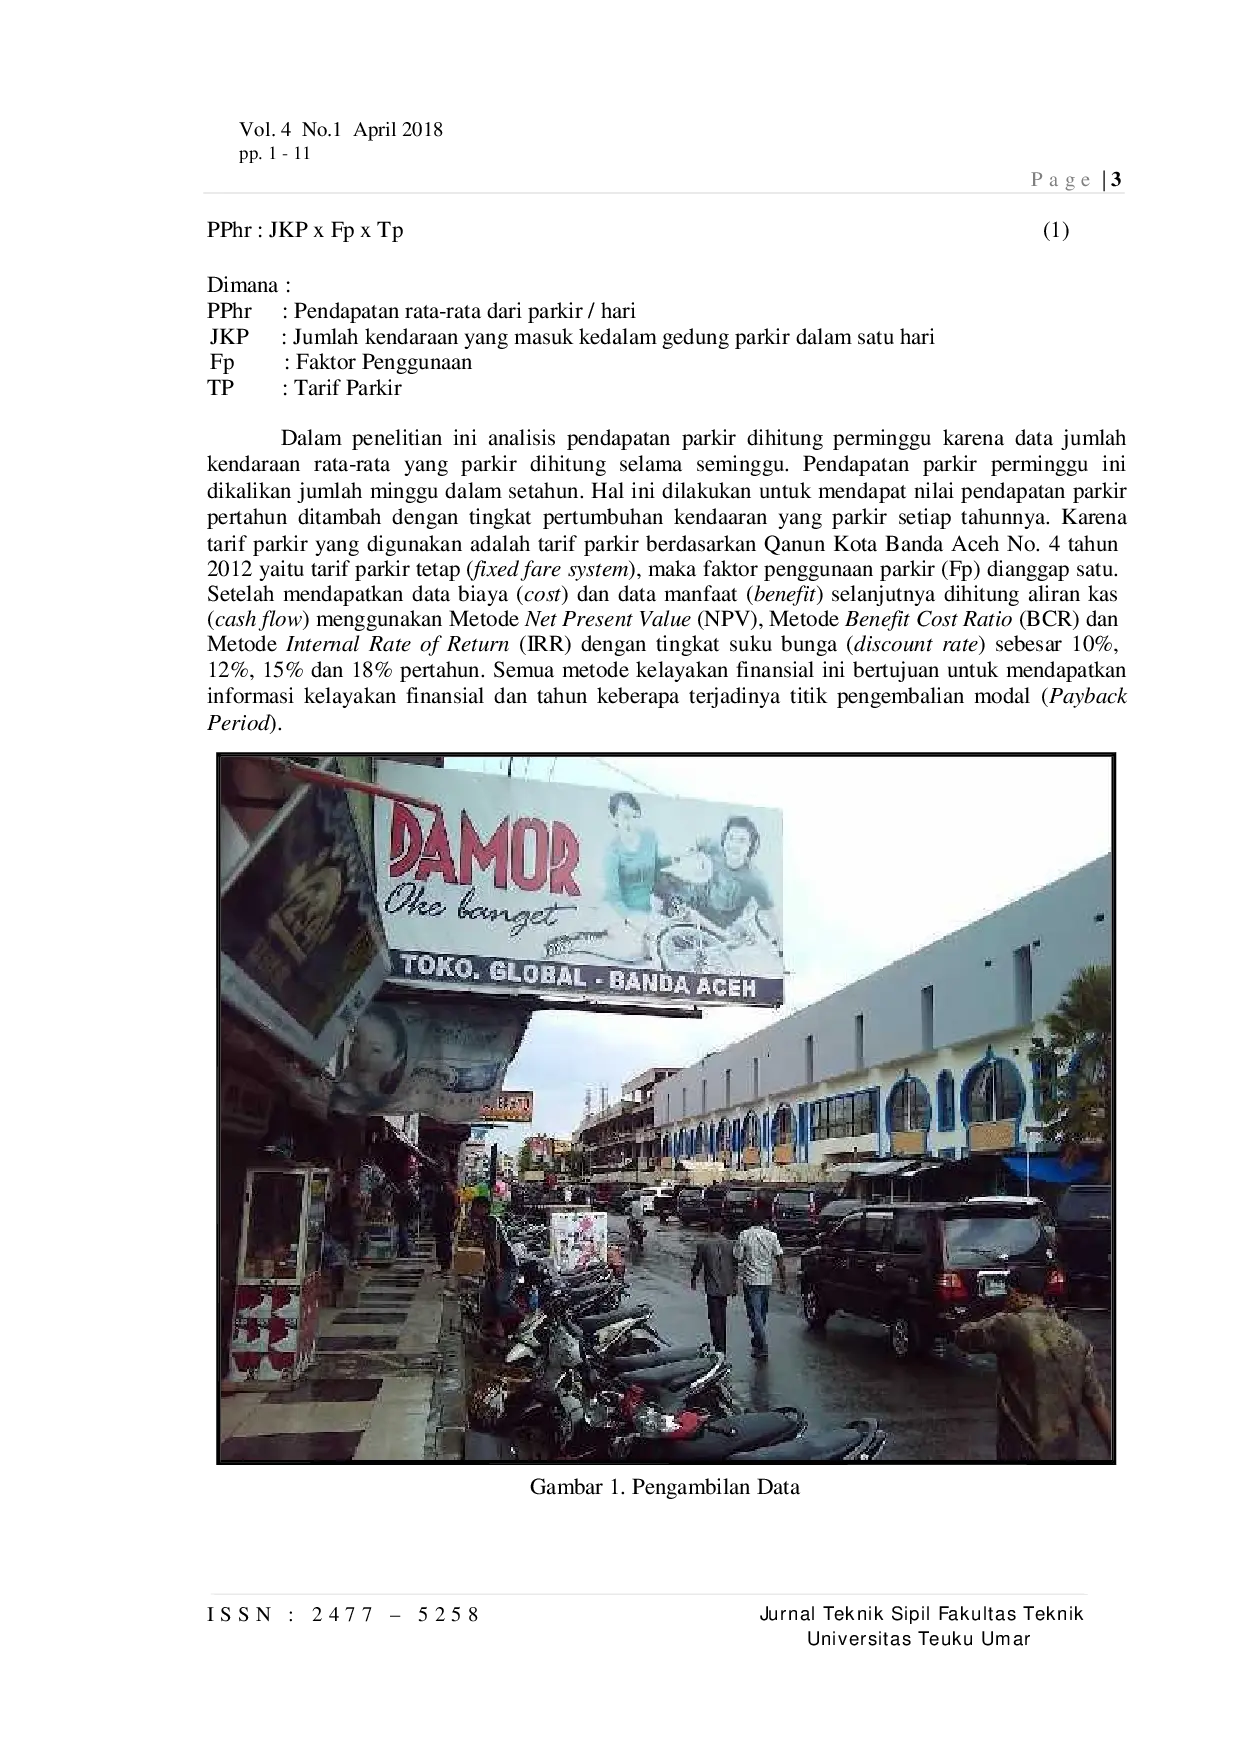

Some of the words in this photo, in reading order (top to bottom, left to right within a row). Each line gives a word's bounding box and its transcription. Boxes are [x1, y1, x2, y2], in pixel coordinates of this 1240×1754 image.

[353, 122, 396, 141] April
[402, 122, 443, 137] 2018
[295, 146, 309, 159] 11
[207, 221, 252, 237] PPhr
[269, 221, 308, 238] JKP
[331, 221, 354, 242] Fp
[377, 221, 403, 242] Tp
[207, 276, 278, 293] Dimana
[207, 302, 252, 318] PPhr
[294, 302, 399, 323] Pendapatan
[405, 305, 481, 319] rata-rata
[487, 302, 522, 319] dari
[528, 302, 583, 323] parkir
[601, 302, 636, 319] hari
[210, 328, 249, 345] JKP
[293, 328, 358, 345] Jumlah
[365, 328, 458, 345] kendaraan
[464, 333, 508, 349] yang
[514, 328, 574, 345] masuk
[579, 328, 657, 345] kedalam
[662, 328, 729, 349] gedung
[735, 328, 790, 349] parkir
[796, 328, 852, 345] dalam
[858, 331, 894, 345] satu
[900, 328, 935, 345] hari
[210, 353, 234, 374] Fp
[296, 353, 356, 370] Faktor
[362, 353, 472, 374] Penggunaan
[207, 379, 234, 395] TP
[294, 379, 341, 396] Tarif
[346, 379, 402, 396] Parkir
[281, 429, 342, 446] Dalam
[352, 429, 442, 450] penelitian
[453, 429, 477, 445] ini
[489, 429, 555, 446] analisis
[567, 429, 670, 450] pendapatan
[682, 429, 736, 450] parkir
[747, 429, 823, 450] dihitung
[833, 429, 931, 450] perminggu
[943, 429, 1004, 446] karena
[1015, 429, 1053, 446] data
[1061, 429, 1126, 450] jumlah
[207, 455, 300, 472] kendaraan
[314, 458, 390, 472] rata-rata
[404, 460, 448, 476] yang
[461, 455, 517, 476] parkir
[530, 455, 606, 476] dihitung
[620, 455, 682, 472] selama
[803, 455, 909, 476] Pendapatan
[923, 455, 977, 476] parkir
[991, 455, 1088, 476] perminggu
[1102, 455, 1126, 471] ini
[207, 508, 287, 529] pertahun
[298, 508, 381, 525] ditambah
[392, 508, 458, 529] dengan
[469, 508, 532, 529] tingkat
[543, 508, 663, 529] pertumbuhan
[674, 508, 767, 525] kendaaran
[778, 513, 822, 529] yang
[832, 508, 887, 529] parkir
[899, 508, 951, 529] setiap
[1062, 508, 1127, 525] Karena
[208, 560, 252, 577] 2012
[259, 560, 304, 581] yaitu
[311, 560, 350, 577] tarif
[355, 560, 410, 581] parkir
[416, 563, 460, 581] tetap
[521, 560, 561, 581] fare
[648, 560, 696, 577] maka
[703, 560, 758, 577] faktor
[764, 565, 873, 581] penggunaan
[880, 560, 935, 581] parkir
[987, 560, 1069, 581] dianggap
[316, 610, 442, 631] menggunakan
[449, 610, 519, 627] Metode
[524, 611, 557, 627] Net
[562, 611, 633, 627] Present
[640, 610, 691, 627] Value
[769, 610, 839, 627] Metode
[845, 610, 910, 631] Benefit
[917, 610, 958, 627] Cost
[963, 611, 1012, 627] Ratio
[1086, 610, 1118, 627] dan
[207, 635, 277, 652] Metode
[286, 635, 360, 652] Internal
[369, 636, 411, 652] Rate
[420, 635, 442, 656] of
[447, 636, 509, 652] Return
[581, 635, 646, 656] dengan
[656, 635, 720, 656] tingkat
[730, 635, 772, 652] suku
[781, 635, 837, 656] bunga
[996, 635, 1062, 652] sebesar
[207, 687, 294, 704] informasi
[304, 687, 396, 708] kelayakan
[406, 687, 484, 704] finansial
[494, 687, 527, 704] dan
[537, 687, 587, 704] tahun
[597, 687, 679, 708] keberapa
[689, 687, 780, 708] terjadinya
[790, 687, 828, 704] titik
[837, 687, 964, 708] pengembalian
[974, 687, 1030, 704] modal
[389, 801, 581, 897] DAMOR
[385, 881, 447, 917] Oke
[457, 885, 578, 937] banget
[489, 962, 588, 987] GLOBAL
[608, 970, 692, 995] BANDA
[695, 978, 756, 998] ACEH
[530, 1478, 603, 1495] Gambar
[632, 1478, 750, 1499] Pengambilan
[757, 1478, 800, 1495] Data
[760, 1606, 814, 1621] Jurnal
[823, 1606, 883, 1621] Teknik
[892, 1606, 929, 1624] Sipil
[939, 1606, 1016, 1621] Fakultas
[1023, 1606, 1083, 1621] Teknik
[808, 1631, 911, 1646] Universitas
[918, 1631, 972, 1646] Teuku
[982, 1631, 1030, 1646] Umar
